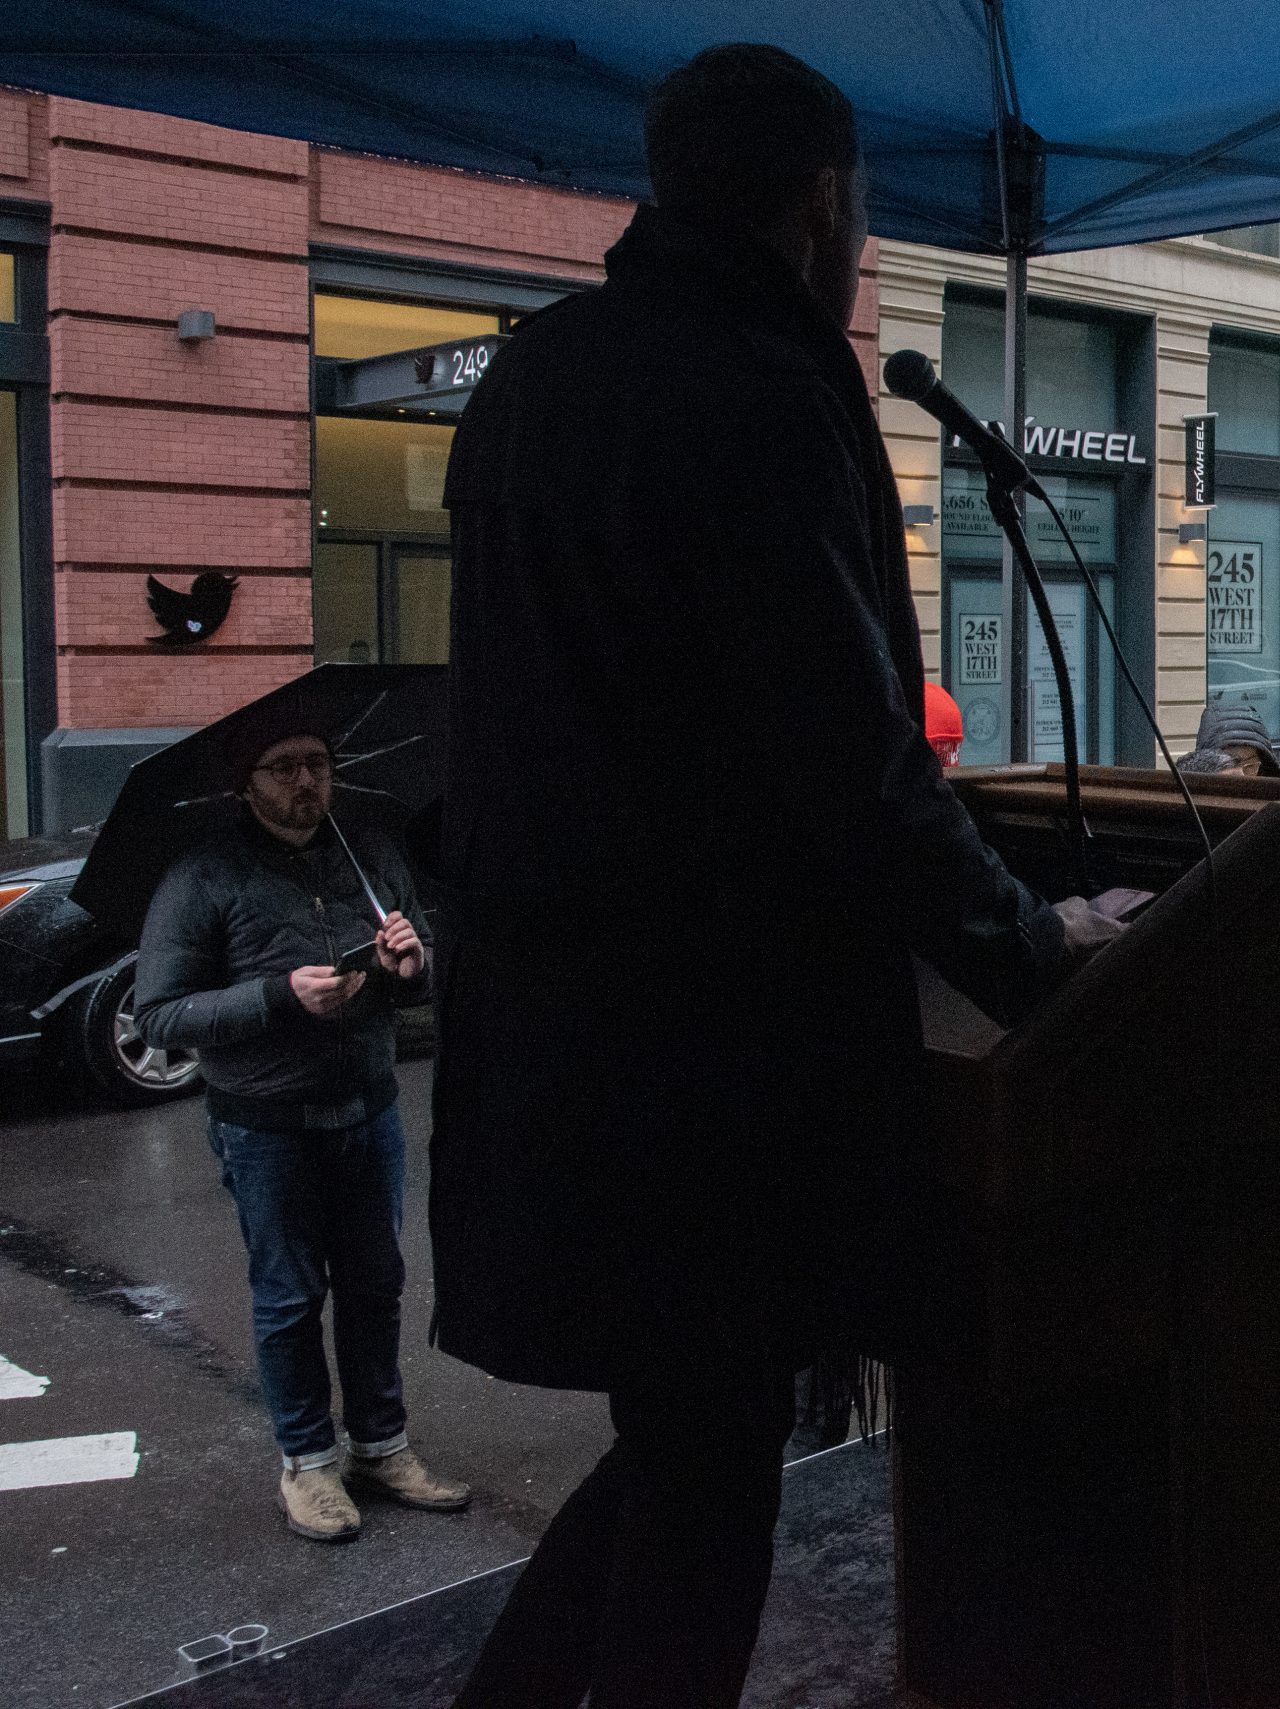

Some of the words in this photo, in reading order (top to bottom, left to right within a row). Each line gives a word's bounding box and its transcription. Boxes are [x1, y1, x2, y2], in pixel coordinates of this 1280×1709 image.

[452, 345, 489, 385] 249
[1193, 420, 1205, 504] FLYWHEEL
[1208, 551, 1255, 584] 245
[1208, 587, 1255, 606] WEST
[1210, 608, 1254, 630] 17TH
[964, 620, 998, 641] 245
[1209, 631, 1255, 645] STREET
[965, 643, 998, 655] WEST
[966, 656, 998, 670] 17TH
[966, 671, 998, 679] STREET
